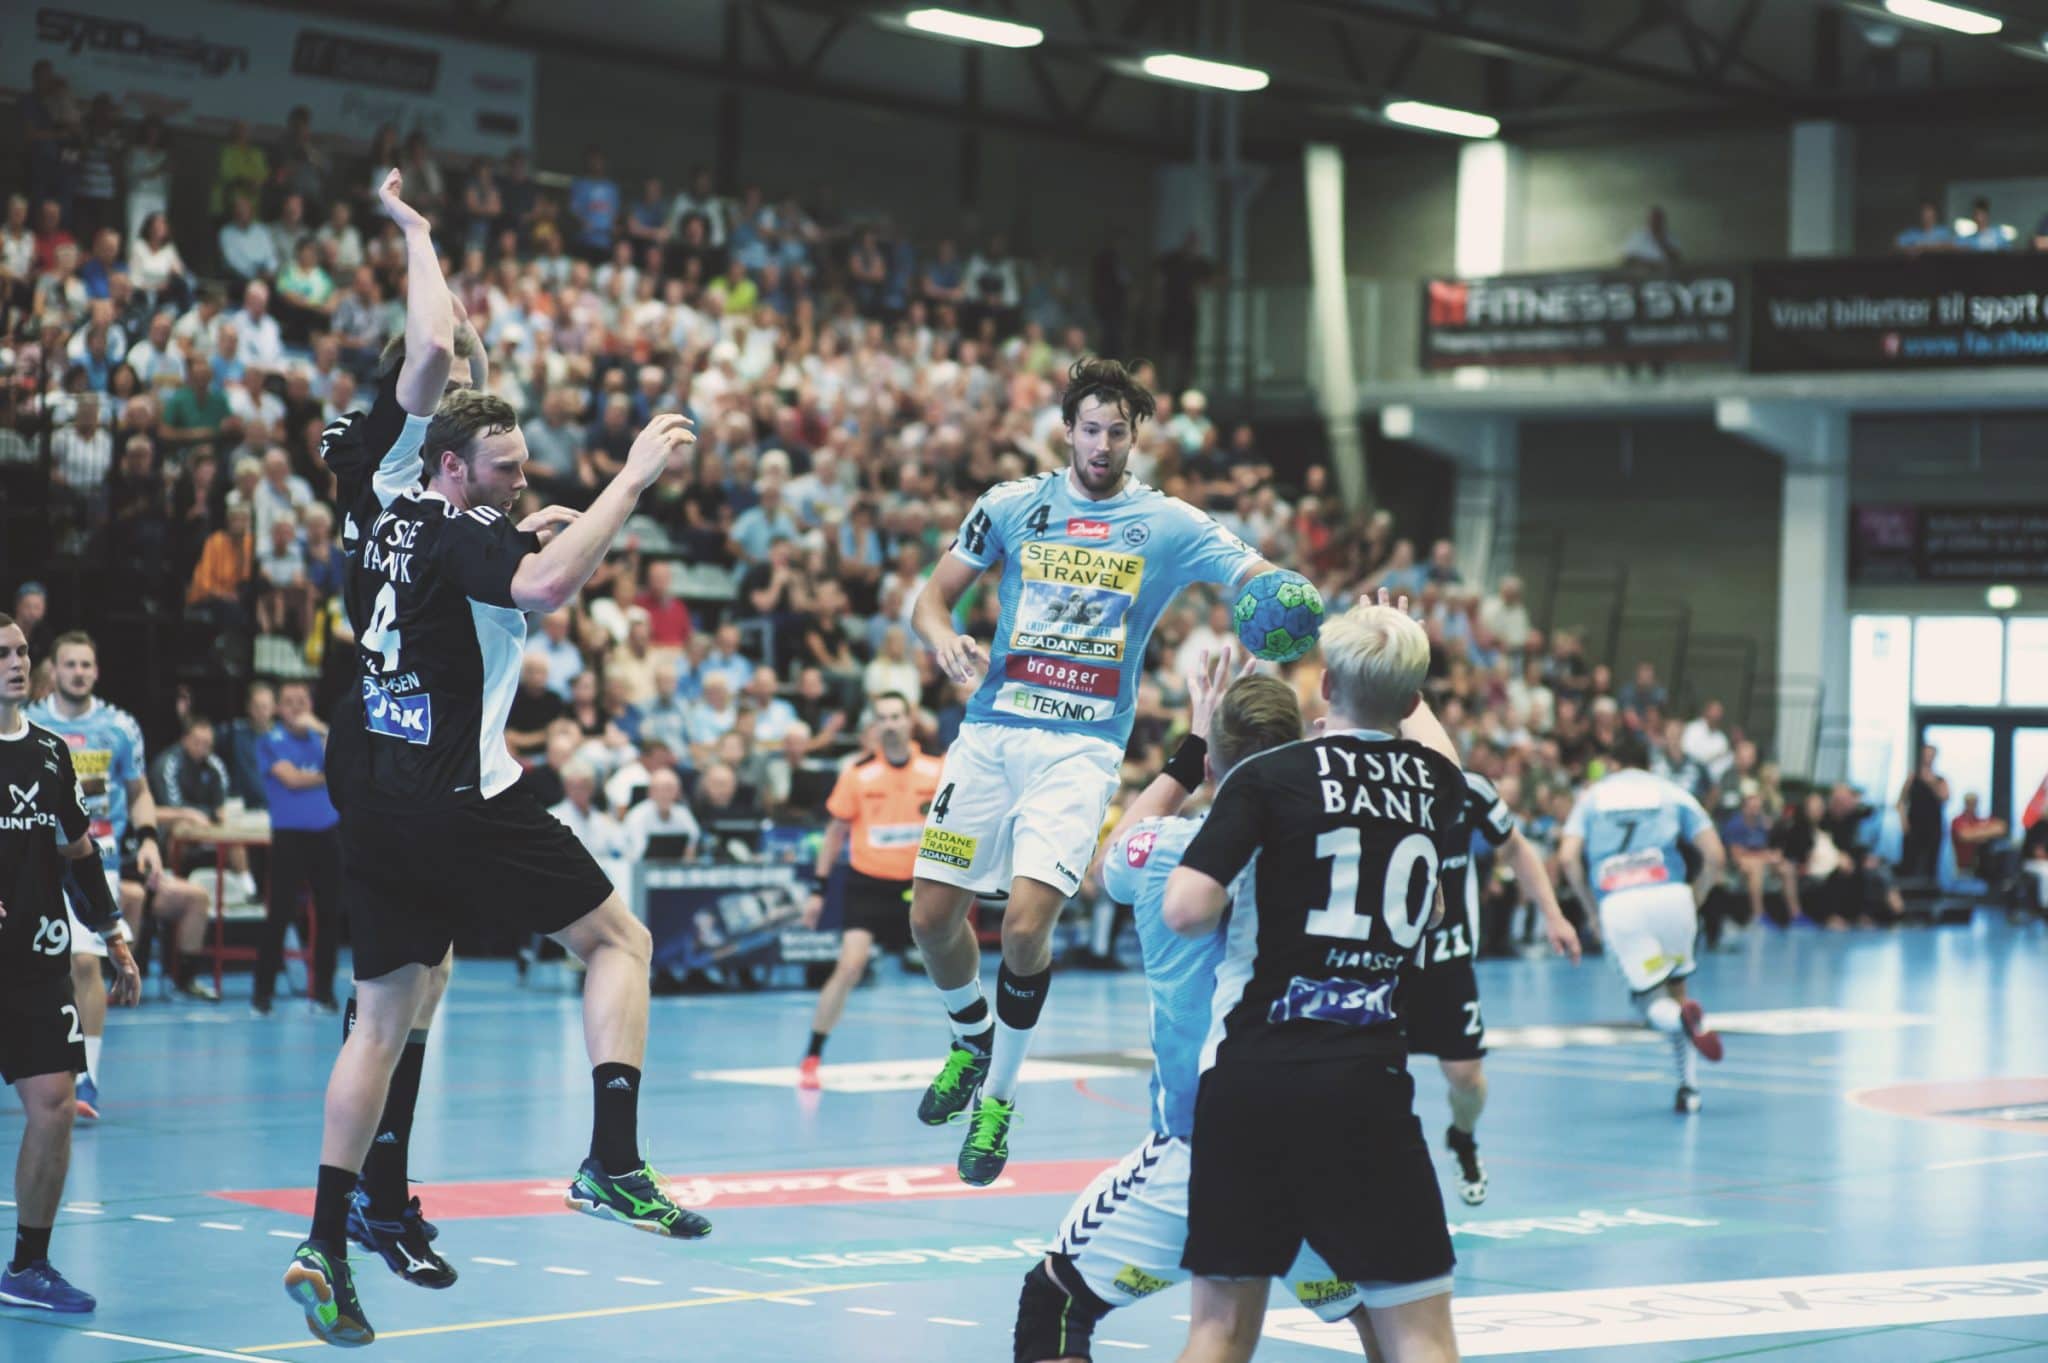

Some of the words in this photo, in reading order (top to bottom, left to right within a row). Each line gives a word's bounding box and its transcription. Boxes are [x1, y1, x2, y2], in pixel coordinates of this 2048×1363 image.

[1969, 293, 2039, 329] sport
[1026, 505, 1052, 538] 4
[361, 580, 401, 672] 4
[1017, 636, 1117, 657] SEADANE.DK
[1027, 656, 1100, 685] broager
[1314, 746, 1436, 790] JYSKE
[933, 782, 956, 824] 4
[1320, 779, 1436, 831] BANK
[1616, 821, 1638, 853] 7
[1304, 826, 1440, 949] 10
[1432, 924, 1470, 963] 21
